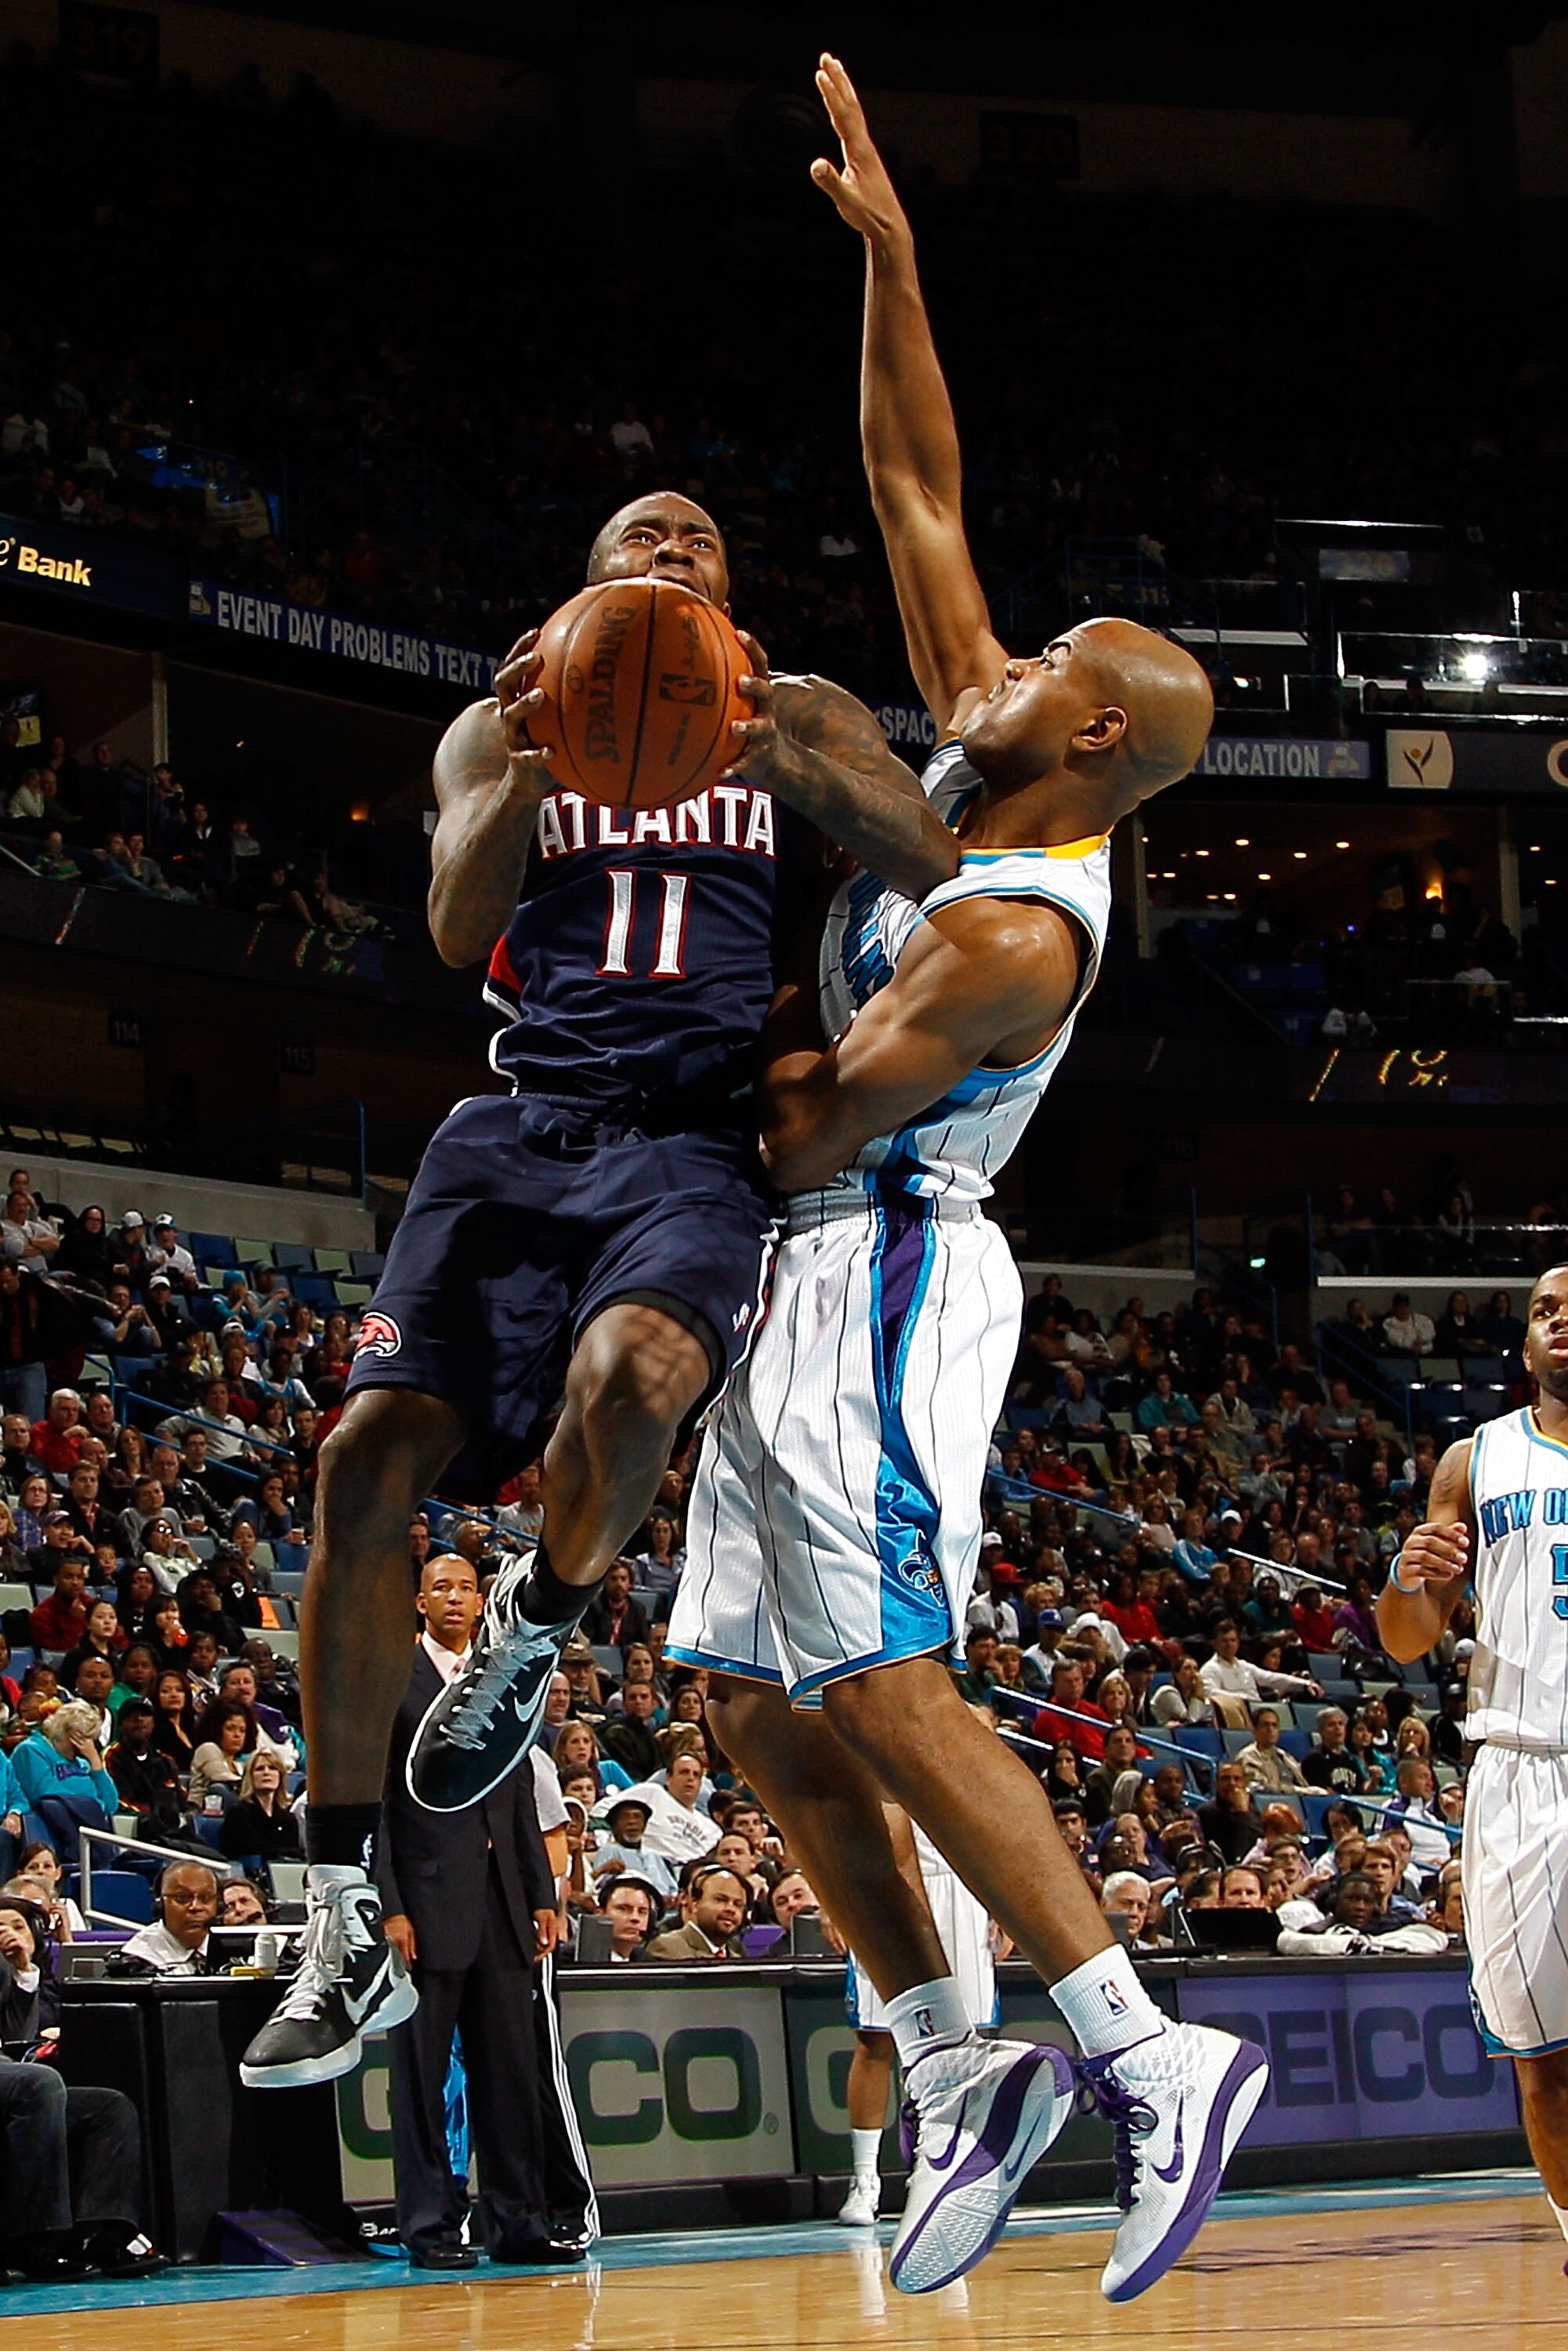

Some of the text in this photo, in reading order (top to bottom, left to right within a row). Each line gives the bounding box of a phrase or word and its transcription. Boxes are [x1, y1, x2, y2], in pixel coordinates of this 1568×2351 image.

[69, 13, 150, 63] 319
[17, 545, 93, 587] Bank
[216, 589, 283, 640] EVENT
[288, 607, 326, 651] DAY
[330, 617, 430, 676] PROBLEMS
[434, 643, 482, 688] TEXT
[586, 605, 640, 765] SPALDING
[1204, 741, 1320, 777] LOCATION
[537, 784, 777, 860] ATLANTA
[596, 867, 690, 980] 11
[112, 1020, 141, 1043] 114
[284, 1045, 312, 1070] 115
[1479, 1489, 1537, 1549] NEW
